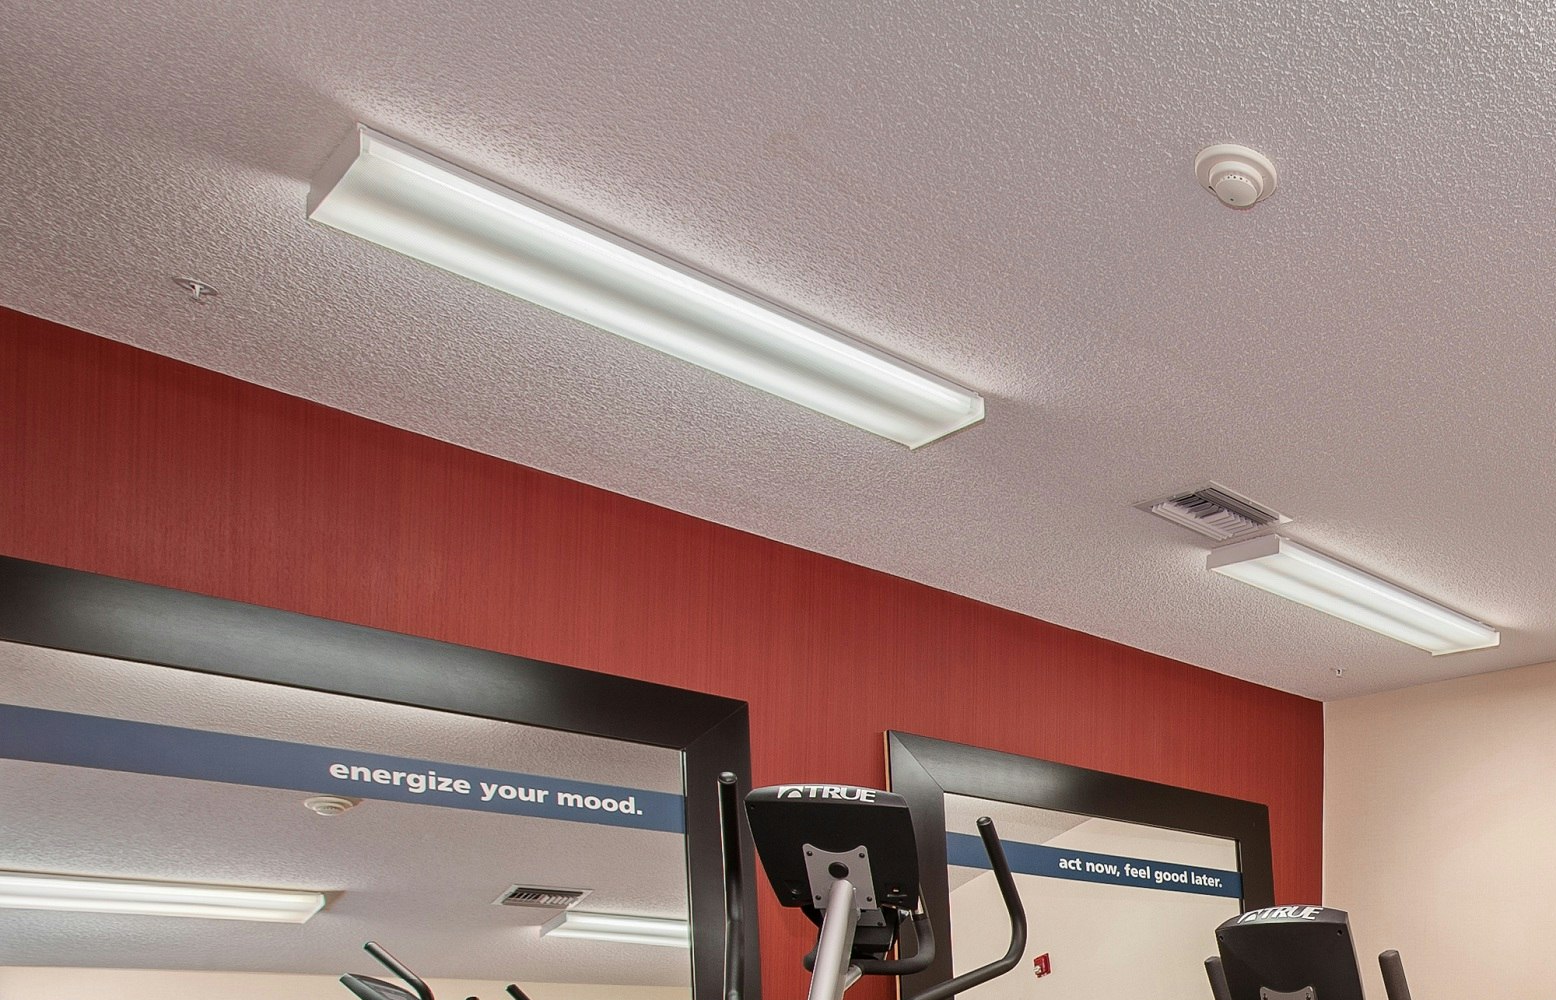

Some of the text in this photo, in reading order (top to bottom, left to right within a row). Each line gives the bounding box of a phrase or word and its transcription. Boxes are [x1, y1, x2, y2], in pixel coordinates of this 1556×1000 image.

[329, 763, 643, 815] energize your mood.
[805, 786, 876, 803] TRUE
[1059, 858, 1223, 888] act now, feel good later.
[1261, 906, 1323, 920] TRUE
